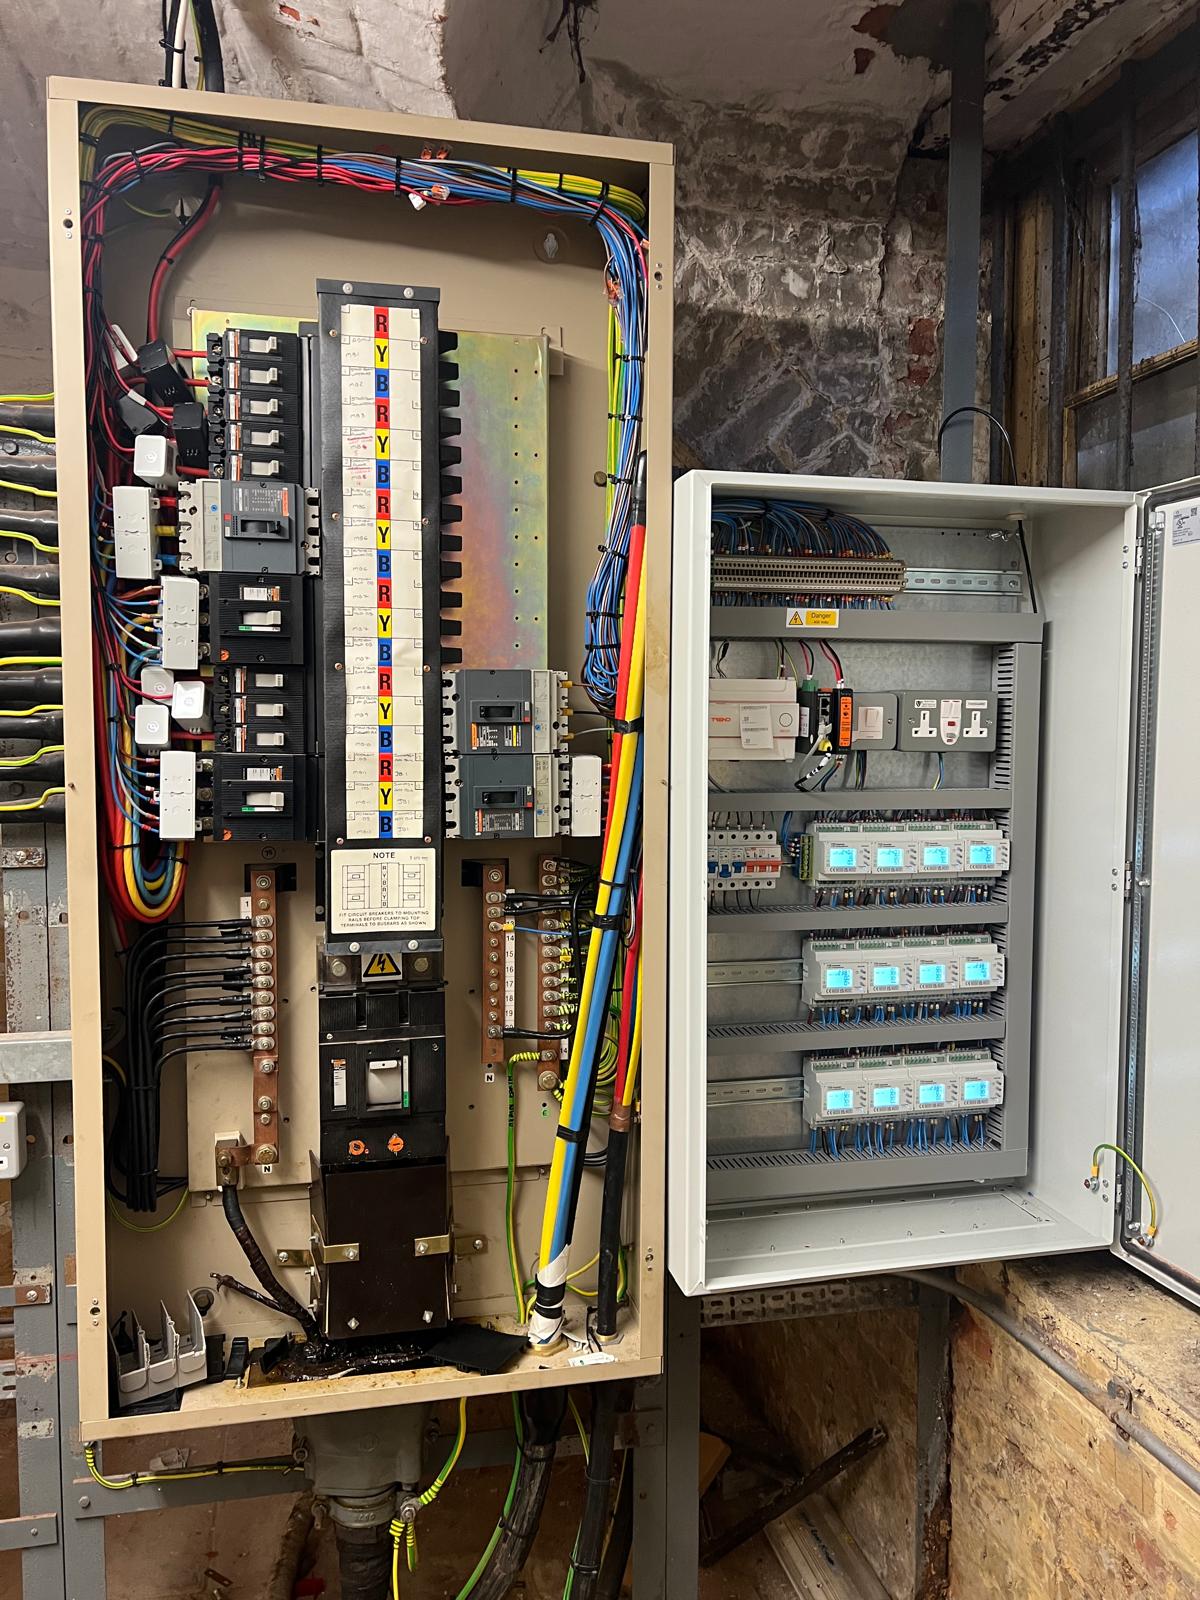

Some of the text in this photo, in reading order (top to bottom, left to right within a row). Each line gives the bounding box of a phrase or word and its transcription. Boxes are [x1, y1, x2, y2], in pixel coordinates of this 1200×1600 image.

[376, 314, 387, 332] R
[376, 345, 387, 362] Y
[377, 375, 388, 391] B
[377, 405, 388, 422] R
[378, 436, 388, 453] Y
[378, 466, 388, 482] B
[378, 496, 389, 513] R
[378, 527, 389, 543] Y
[379, 555, 390, 572] B
[379, 585, 390, 602] R
[379, 615, 390, 631] Y
[380, 645, 390, 660] B
[380, 673, 390, 690] R
[380, 703, 391, 719] Y
[380, 732, 391, 747] B
[381, 760, 391, 775] R
[381, 789, 391, 804] Y
[381, 817, 391, 832] B
